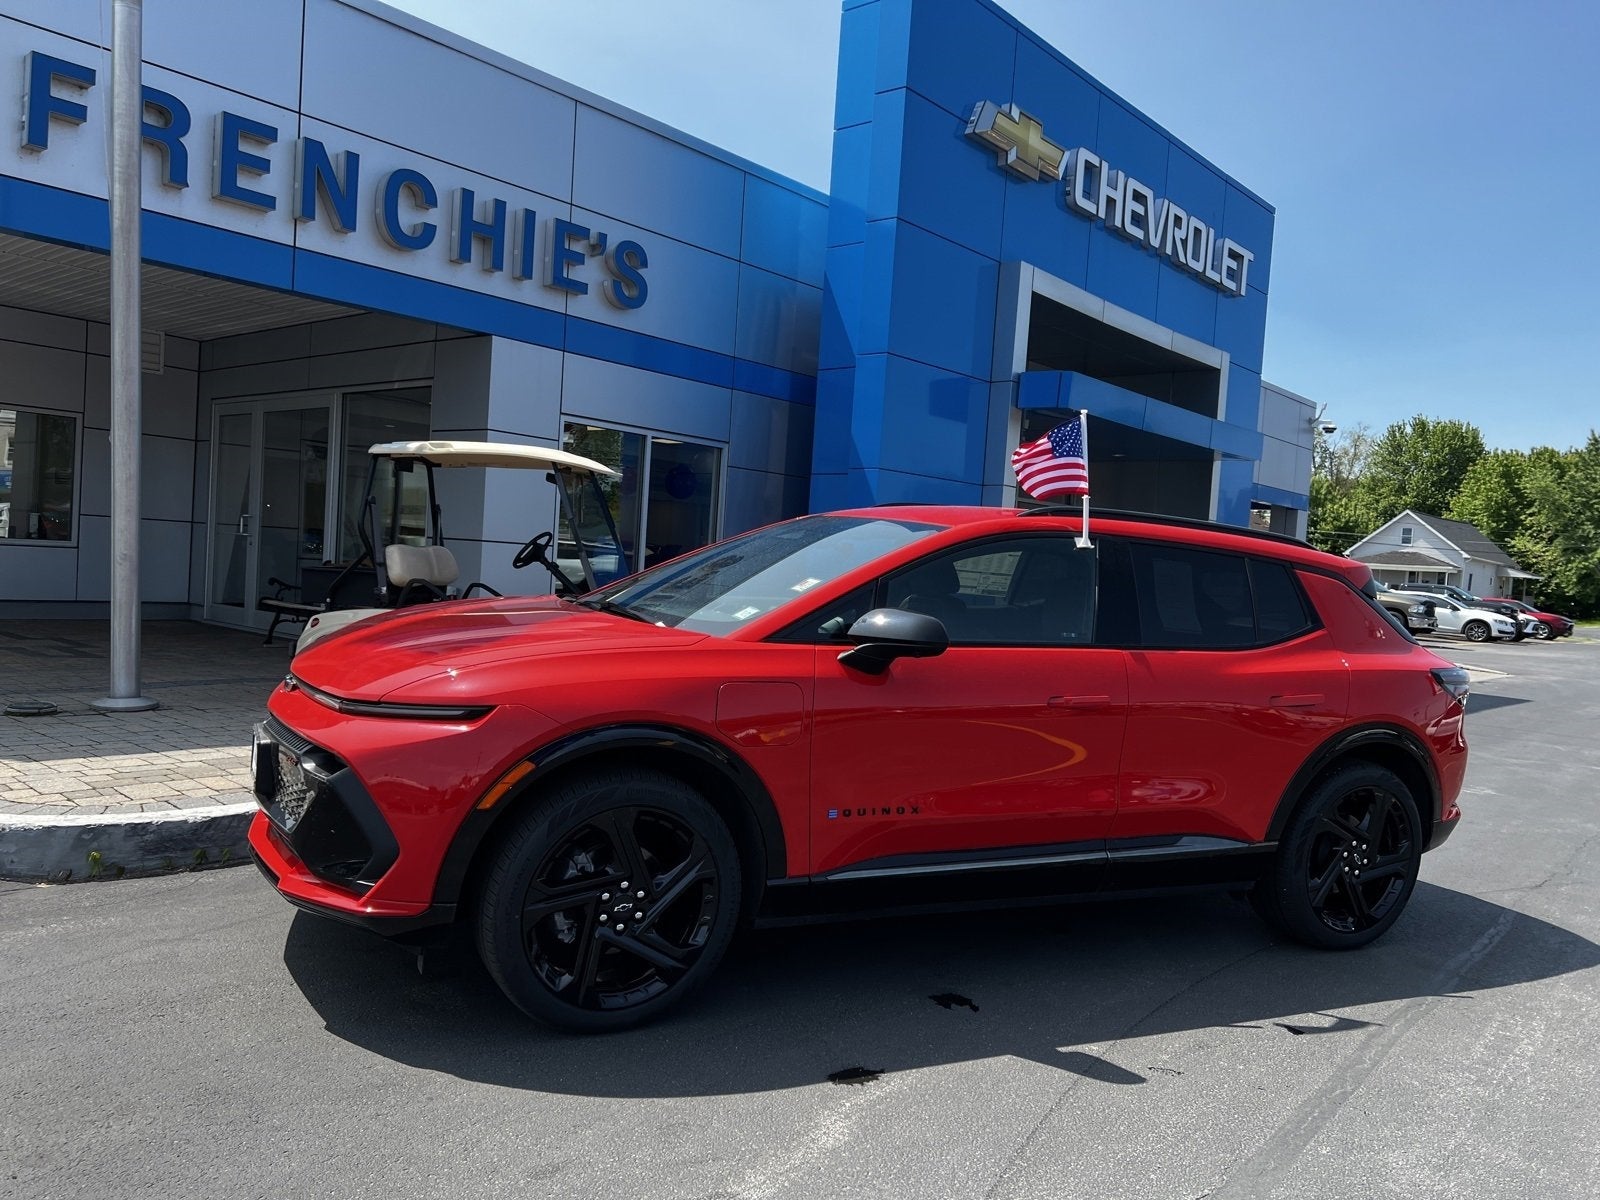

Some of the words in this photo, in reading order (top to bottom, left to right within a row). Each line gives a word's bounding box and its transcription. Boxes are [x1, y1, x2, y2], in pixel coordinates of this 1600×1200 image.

[21, 50, 649, 311] FRENCHIE'S
[1067, 146, 1255, 297] CHEVROLET
[828, 806, 920, 819] EQUINOX
